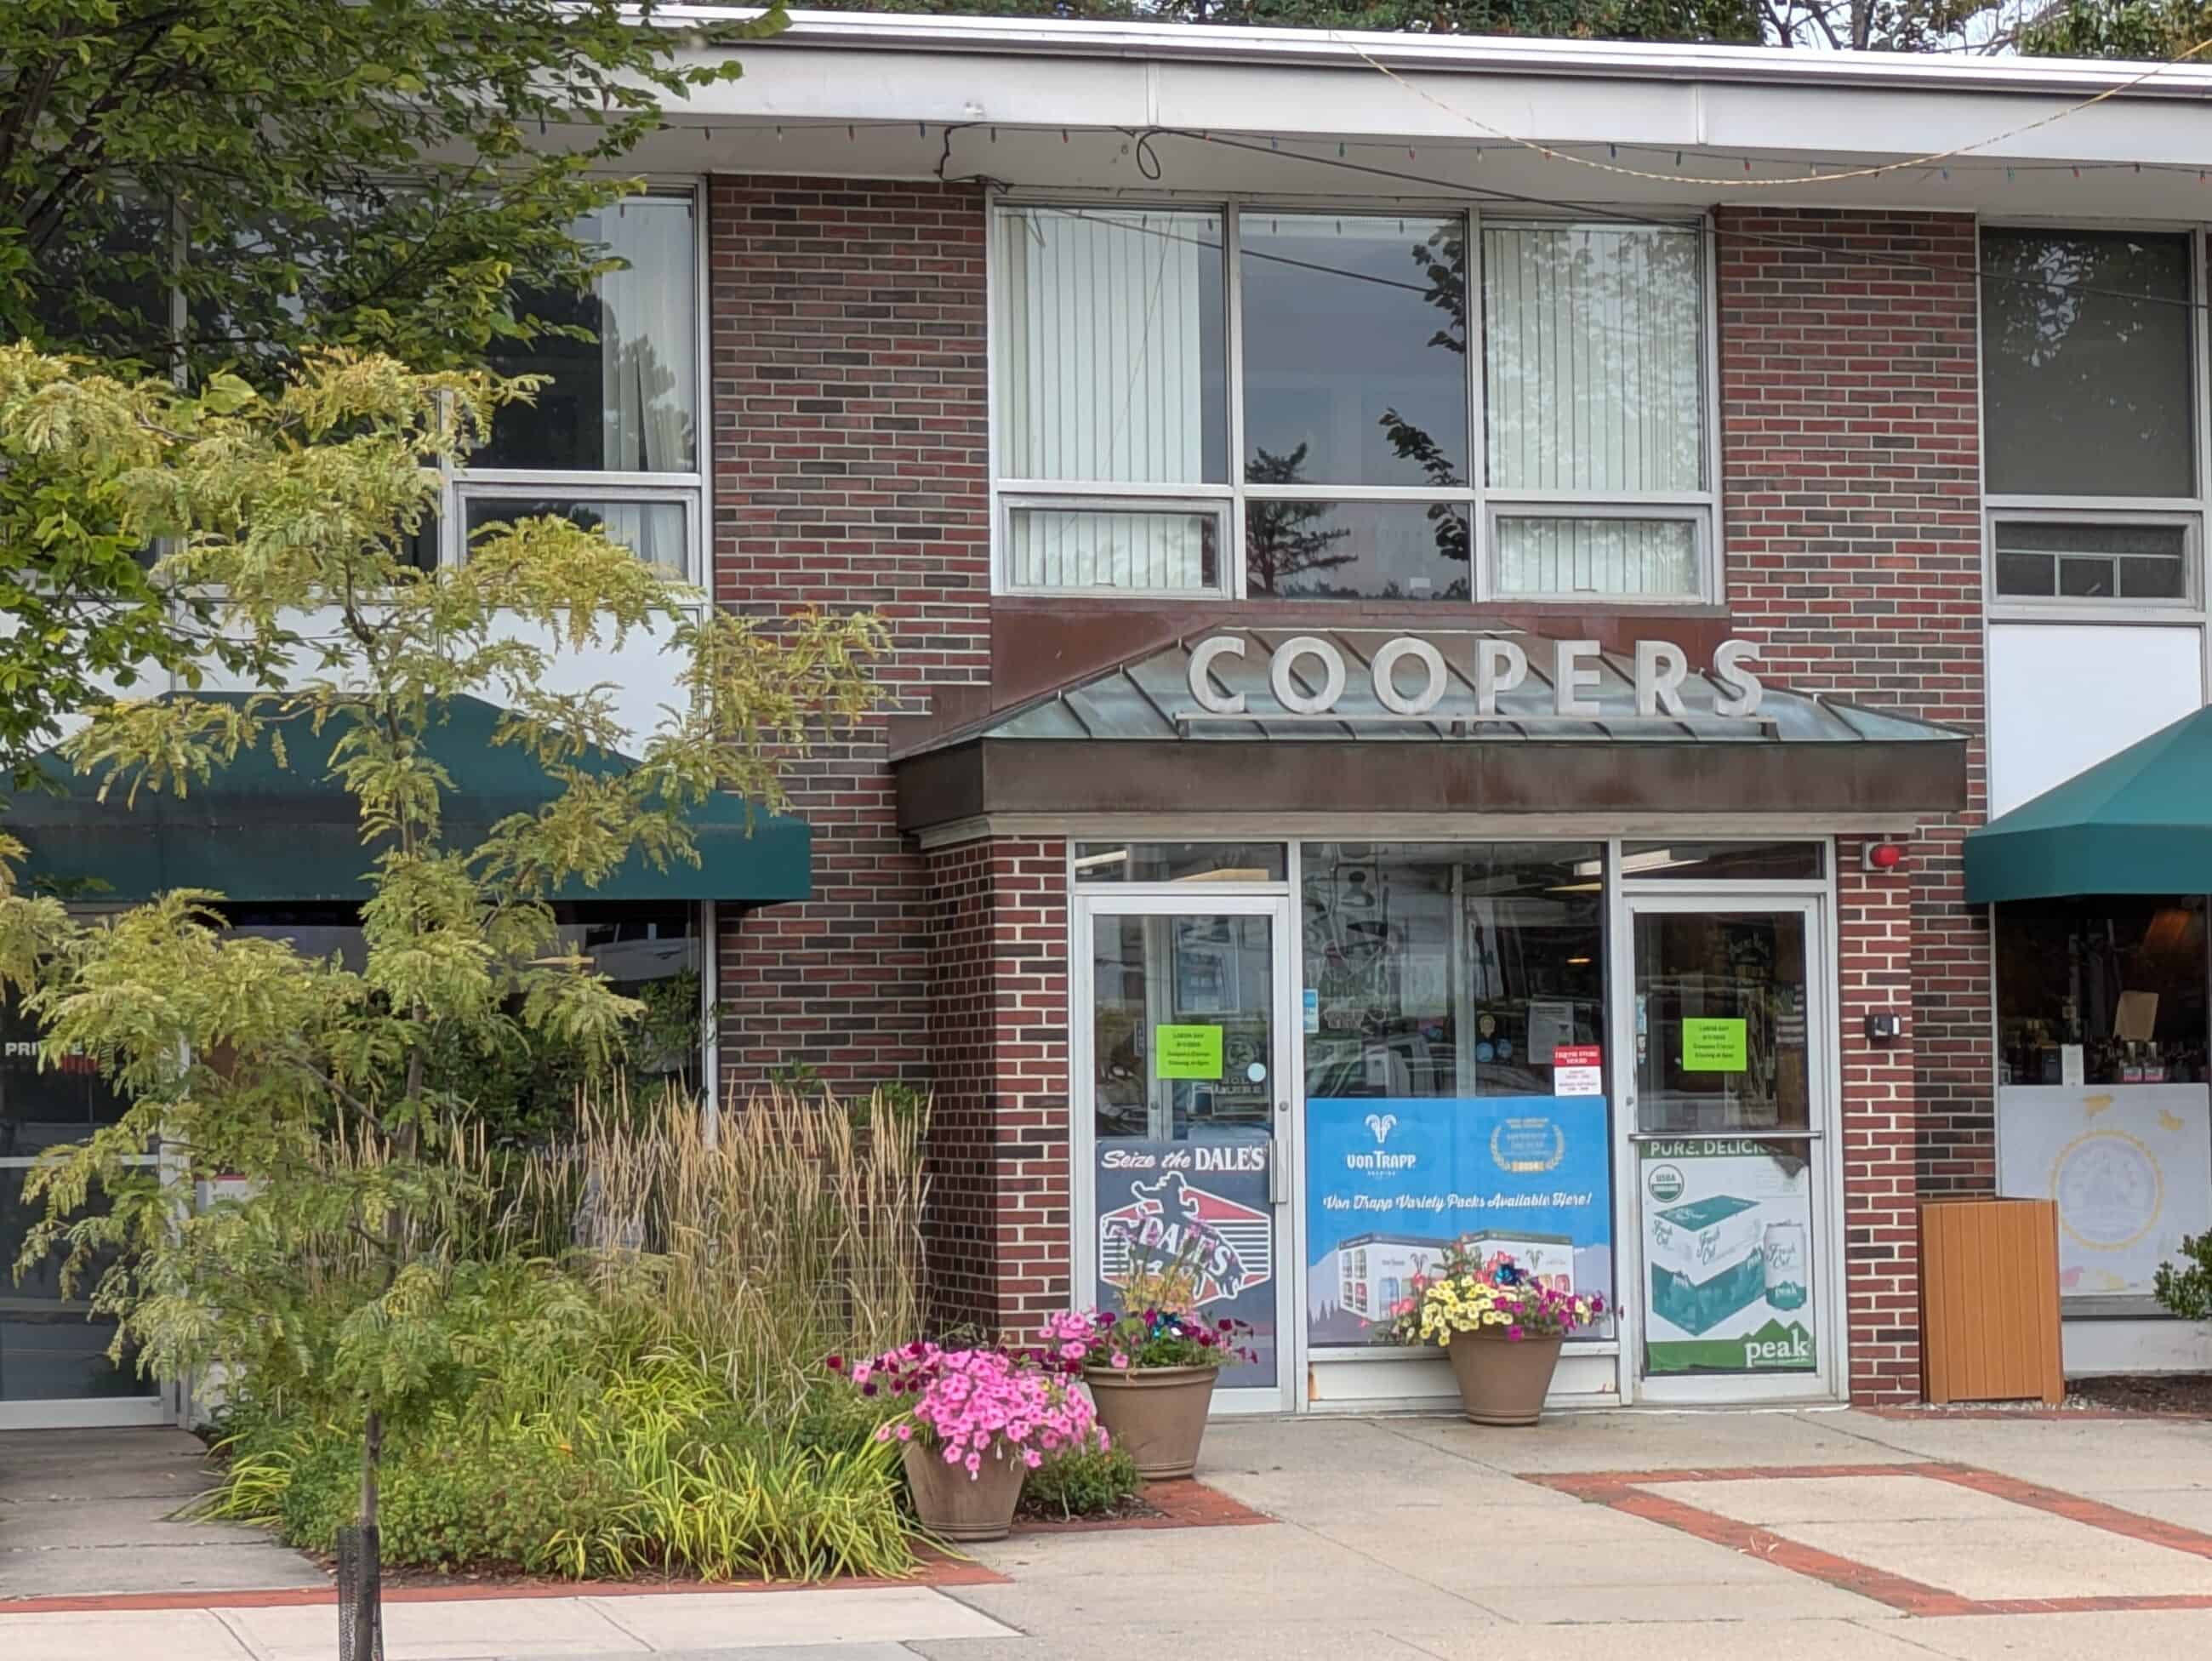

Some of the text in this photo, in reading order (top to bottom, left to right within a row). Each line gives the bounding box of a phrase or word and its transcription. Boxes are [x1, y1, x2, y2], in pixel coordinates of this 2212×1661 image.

[1186, 636, 1764, 717] COOPERS
[5, 1042, 83, 1056] PRIE
[1101, 1145, 1266, 1171] Seize the DALE'S
[1395, 1192, 1445, 1213] Variety
[1446, 1193, 1485, 1210] Packs
[1744, 1327, 1810, 1368] peak
